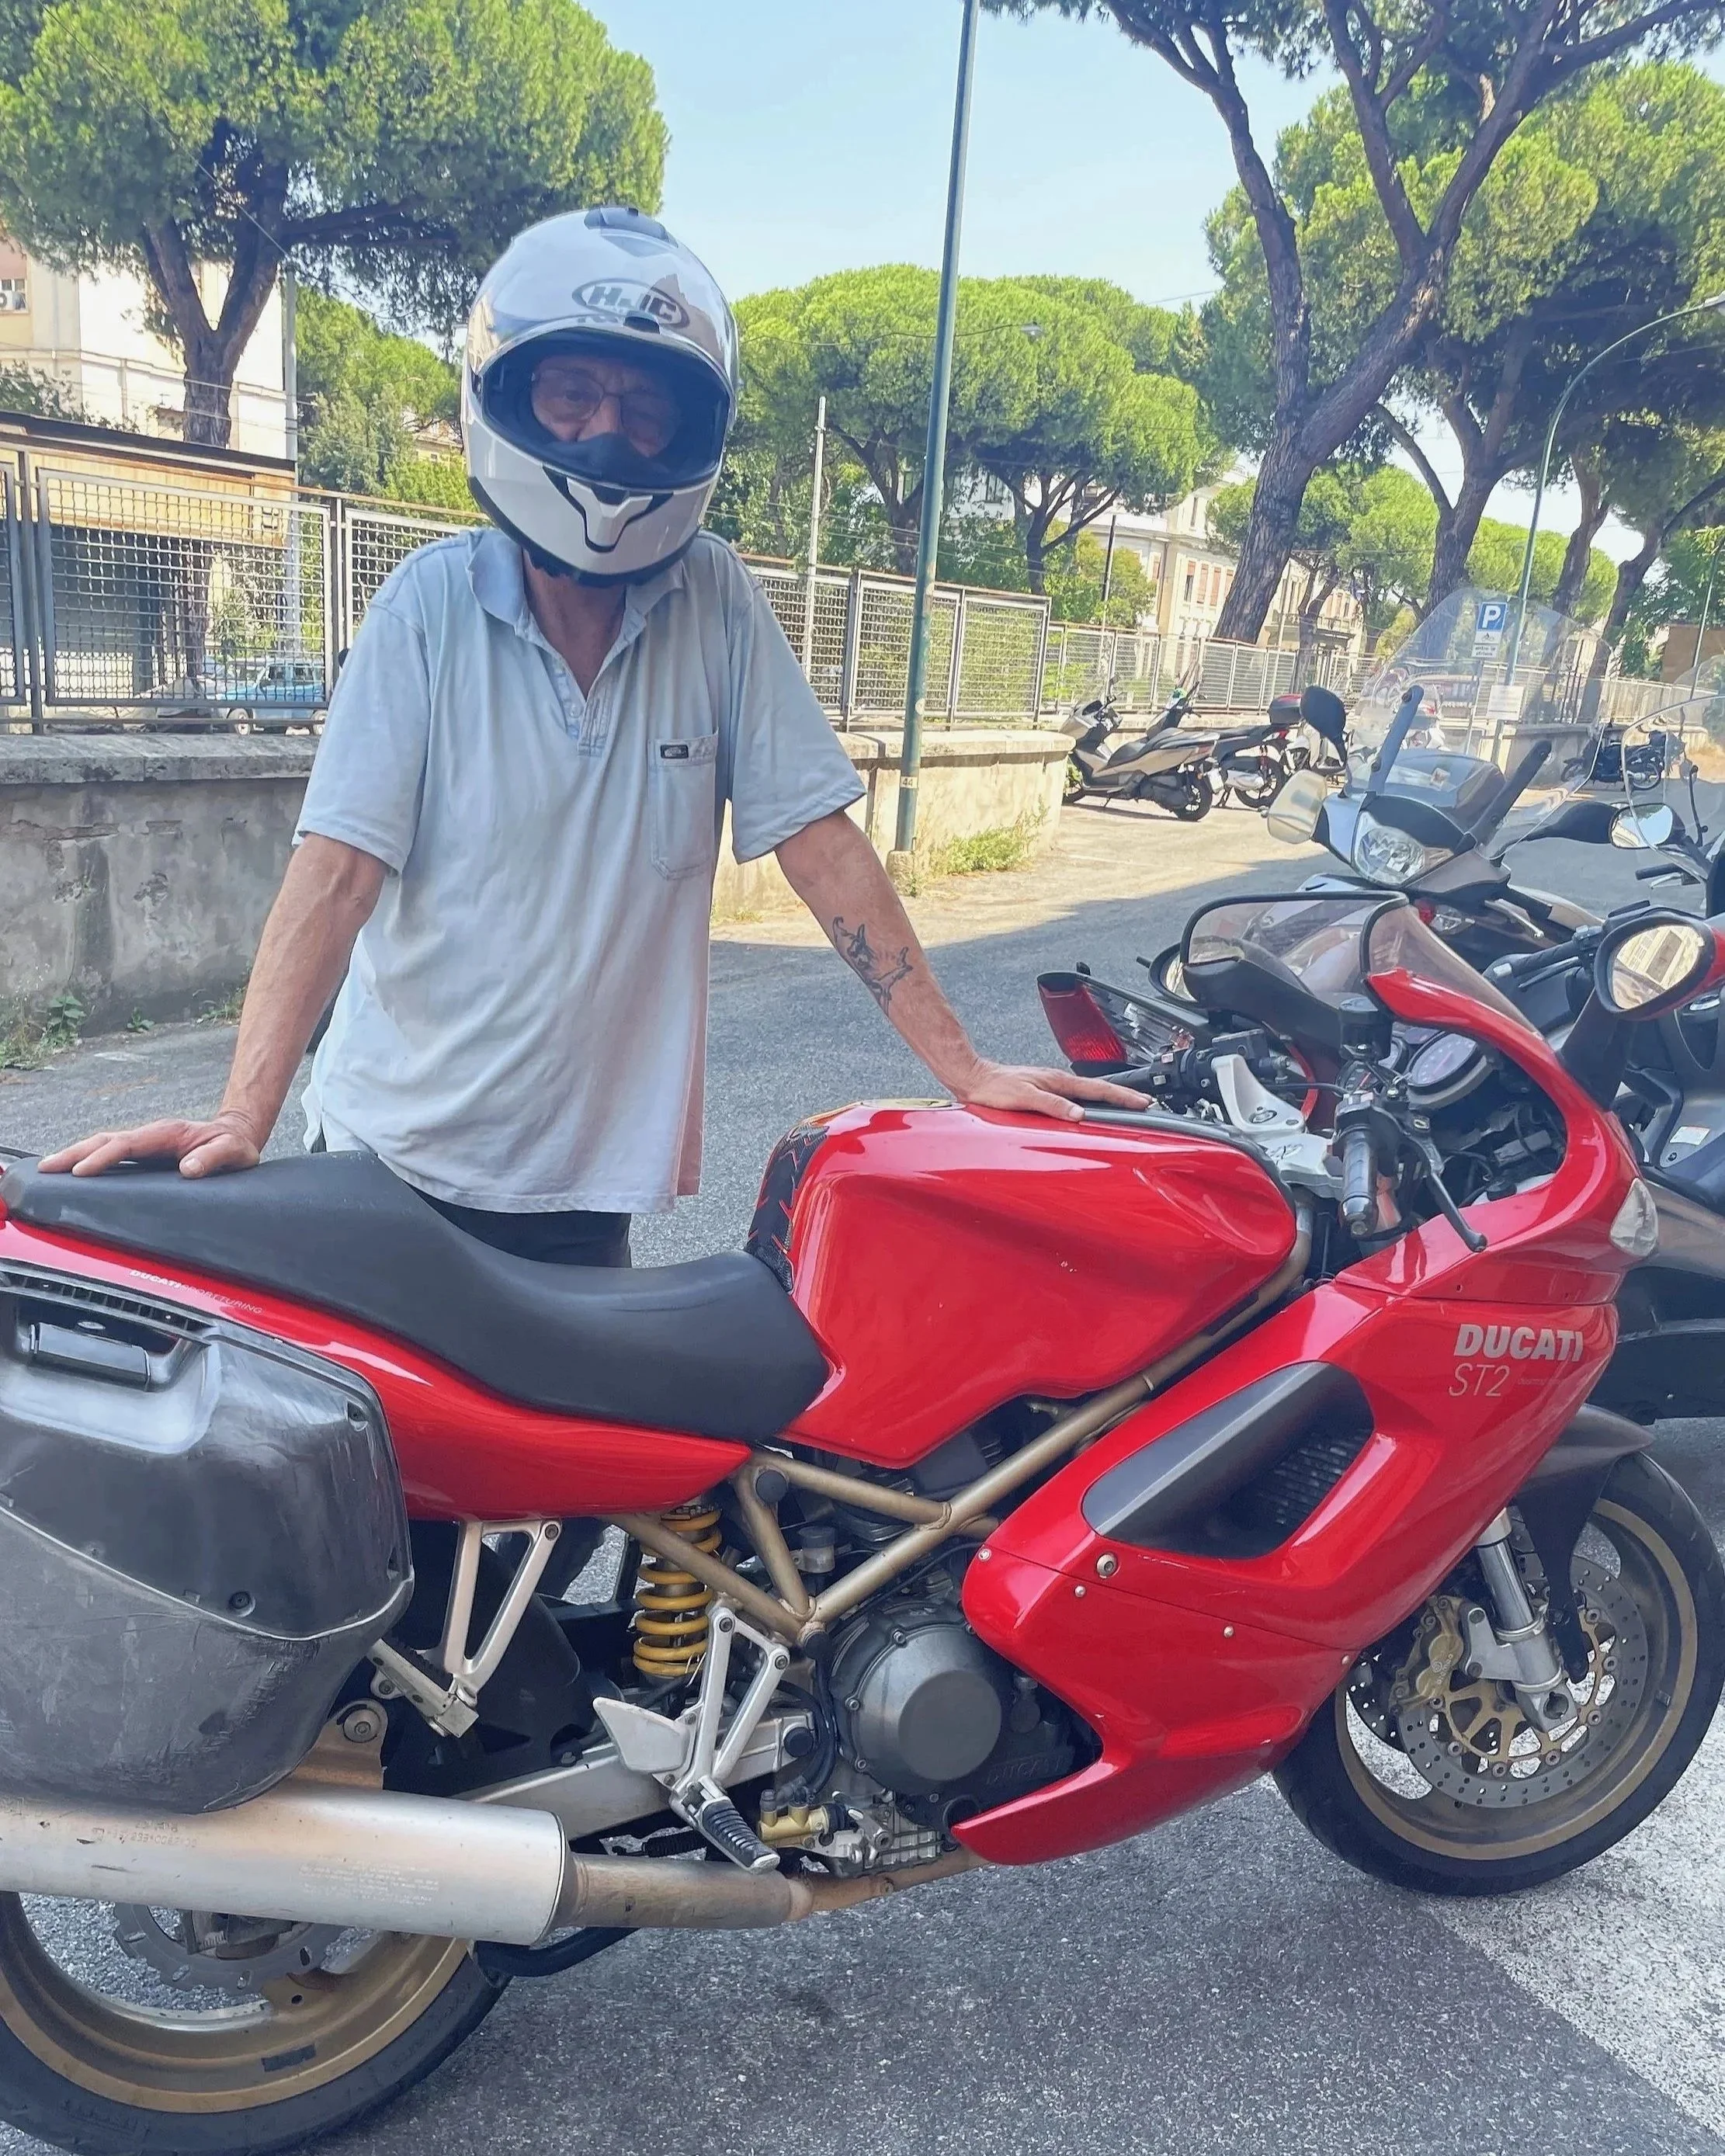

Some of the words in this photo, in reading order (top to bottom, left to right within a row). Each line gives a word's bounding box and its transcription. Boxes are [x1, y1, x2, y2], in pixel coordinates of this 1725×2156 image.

[587, 285, 678, 322] HJC
[1482, 605, 1501, 629] P
[902, 777, 913, 787] 44
[1453, 1324, 1584, 1362] DUCATI
[1448, 1363, 1511, 1397] ST2
